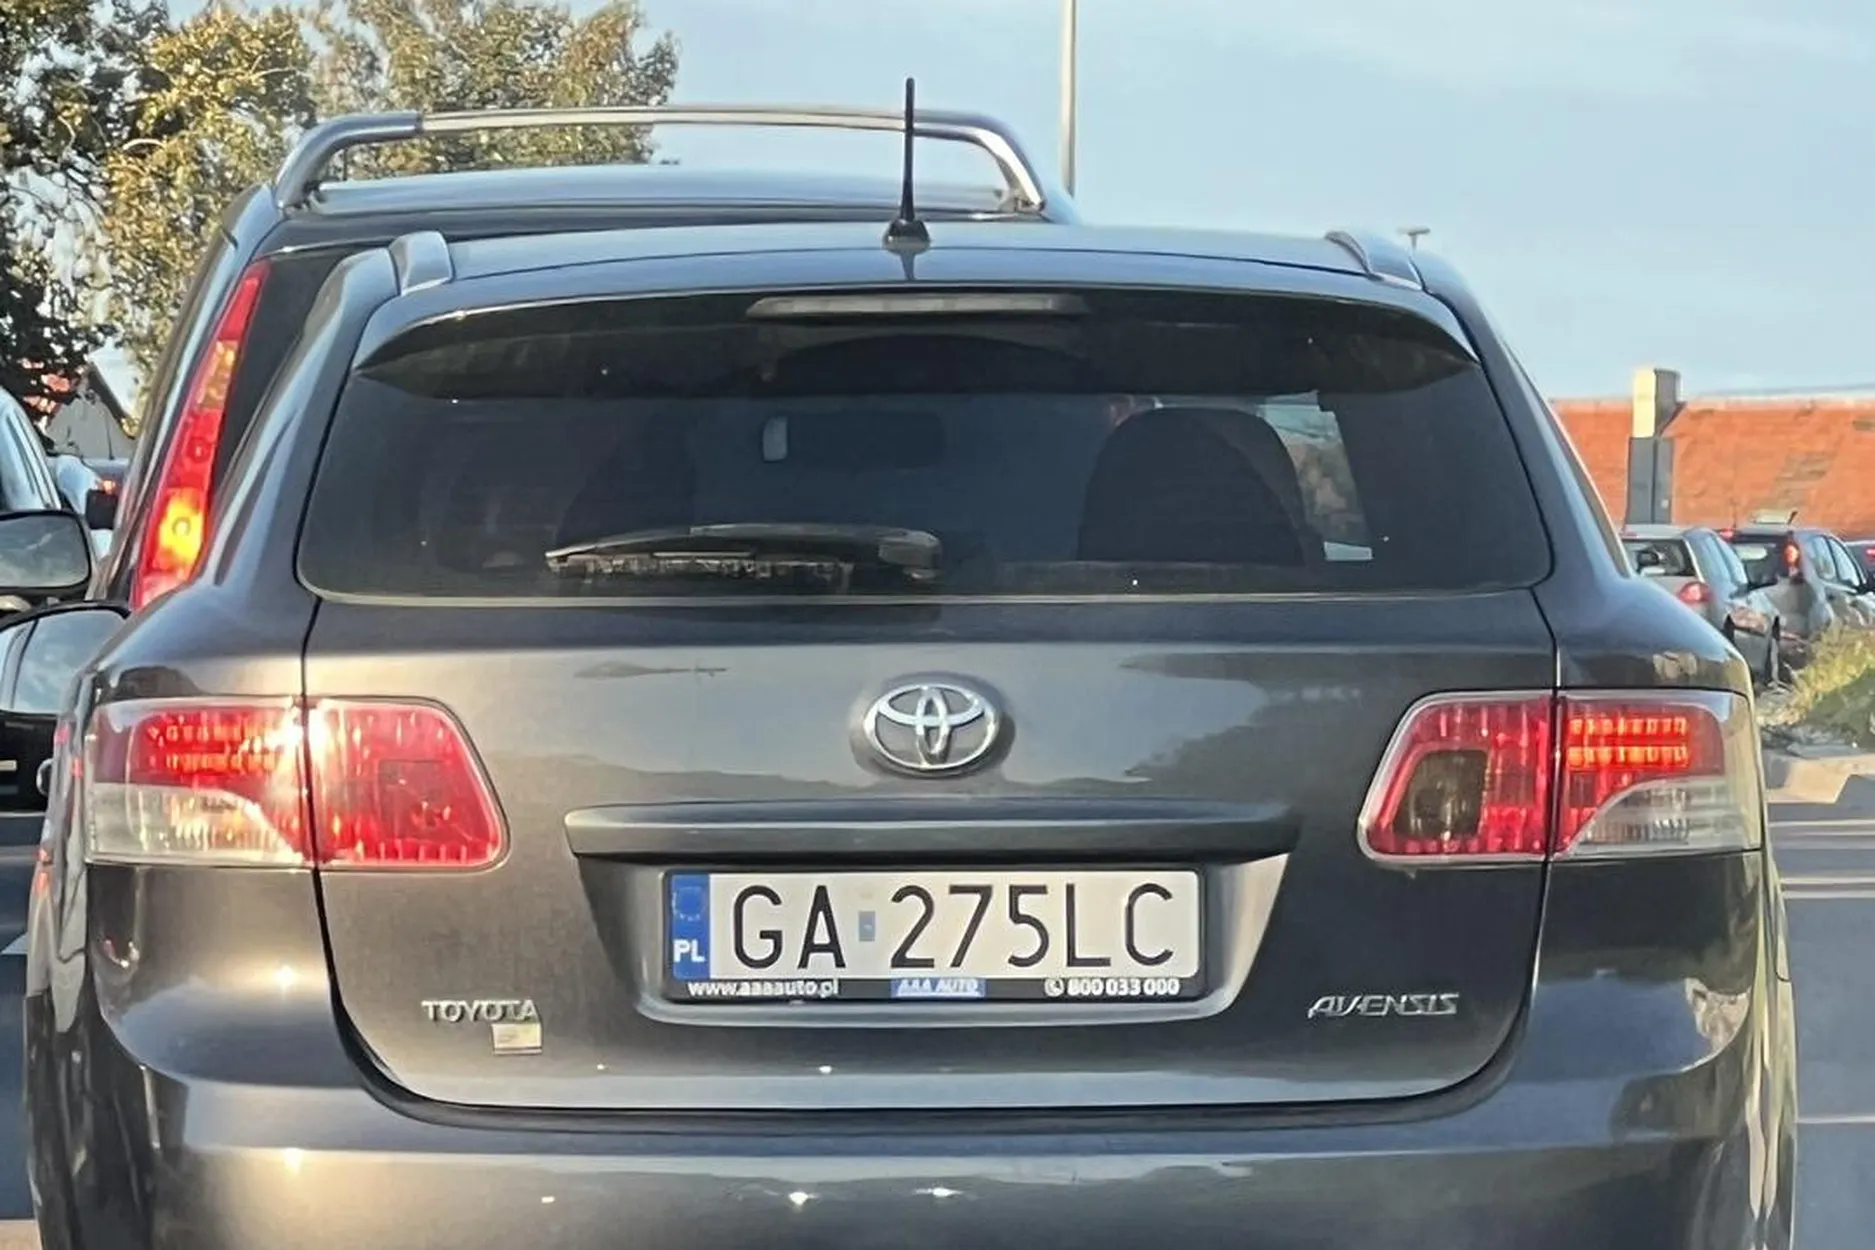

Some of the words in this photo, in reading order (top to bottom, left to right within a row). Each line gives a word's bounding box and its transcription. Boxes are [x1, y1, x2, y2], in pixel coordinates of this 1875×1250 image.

[732, 885, 847, 969] GA
[890, 883, 1174, 969] 275LC
[673, 939, 706, 963] PL
[687, 979, 840, 998] www.aaaauto.pl
[1143, 978, 1181, 997] 000
[421, 999, 542, 1023] TOYOTA
[1307, 993, 1460, 1019] AVENSIS
